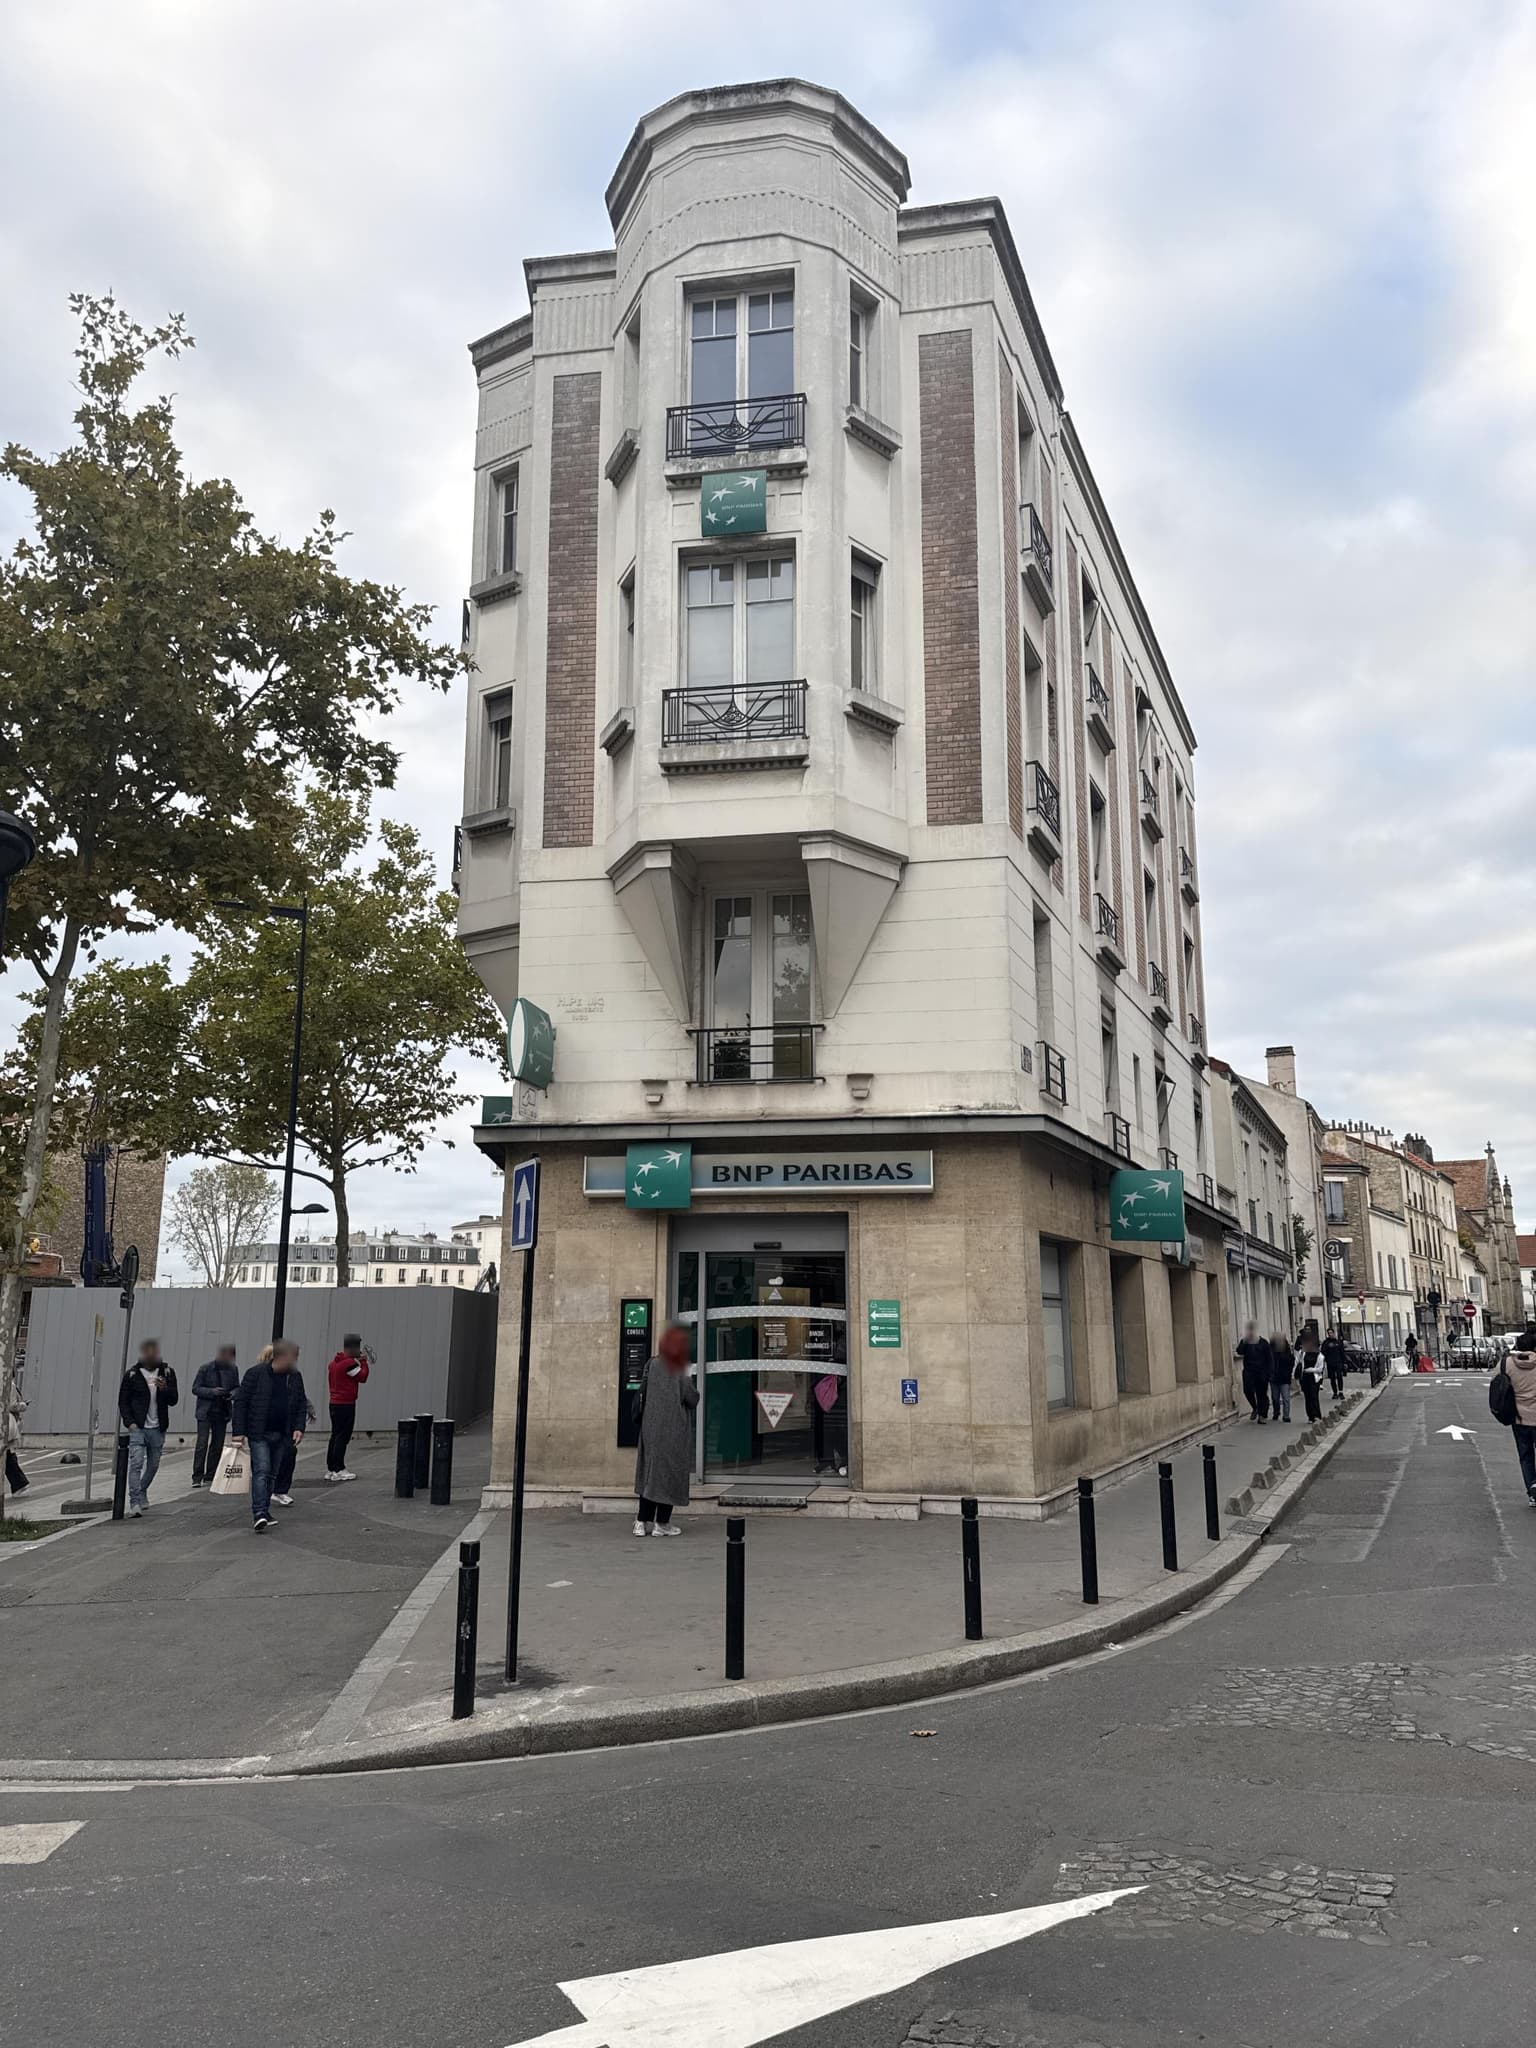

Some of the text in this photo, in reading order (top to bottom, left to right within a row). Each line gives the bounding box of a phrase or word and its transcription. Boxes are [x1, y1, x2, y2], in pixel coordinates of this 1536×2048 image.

[712, 1162, 914, 1182] BNP PARIBAS
[1328, 1244, 1340, 1254] 21
